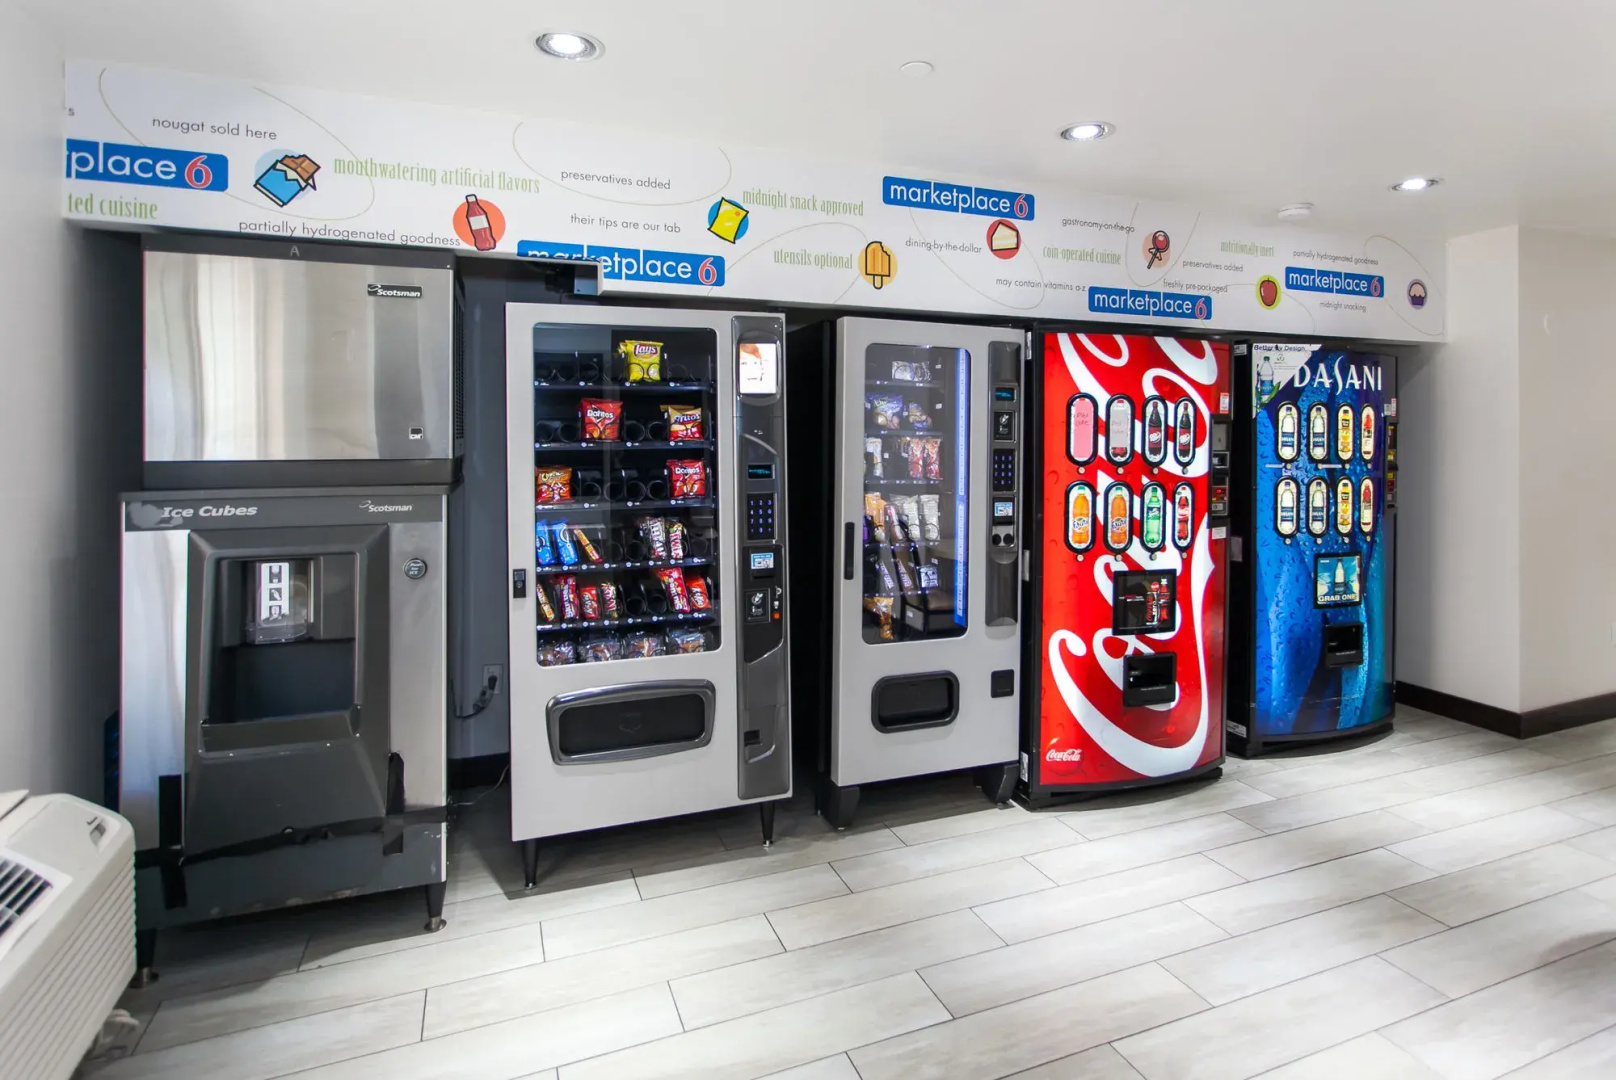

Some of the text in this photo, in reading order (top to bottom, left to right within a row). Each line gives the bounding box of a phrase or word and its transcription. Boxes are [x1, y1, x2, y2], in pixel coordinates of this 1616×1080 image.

[152, 117, 277, 140] nougat sold here
[184, 155, 213, 189] 6
[334, 157, 540, 194] mouthwatering artificial flavors
[561, 170, 671, 190] preservatives added
[67, 192, 158, 219] ted cuisine
[743, 188, 864, 216] midnight snack approved
[890, 181, 1028, 218] marketplace 6
[239, 221, 461, 246] partially hydrogenated goodness
[571, 213, 681, 234] their tips are our tab
[290, 246, 300, 257] A
[905, 236, 982, 254] dining-by-the-dollar
[774, 248, 853, 269] utensils optional
[1043, 246, 1121, 266] coin-operated cuisine
[1183, 260, 1244, 272] preservatives added
[1293, 250, 1379, 266] partially hydrogenated goodness
[698, 257, 717, 285] 6
[996, 278, 1086, 292] may contain vitamins a-z
[1163, 277, 1183, 289] freshly
[1289, 269, 1381, 296] marketplace 6
[377, 288, 421, 298] Scotsman
[1094, 289, 1207, 320] marketplace 6
[1319, 300, 1366, 313] midnight snacking
[1294, 356, 1381, 395] DASANI
[161, 505, 257, 518] Ice Cubes
[368, 504, 412, 513] Scotsman
[1046, 748, 1083, 762] Coca-Cola
